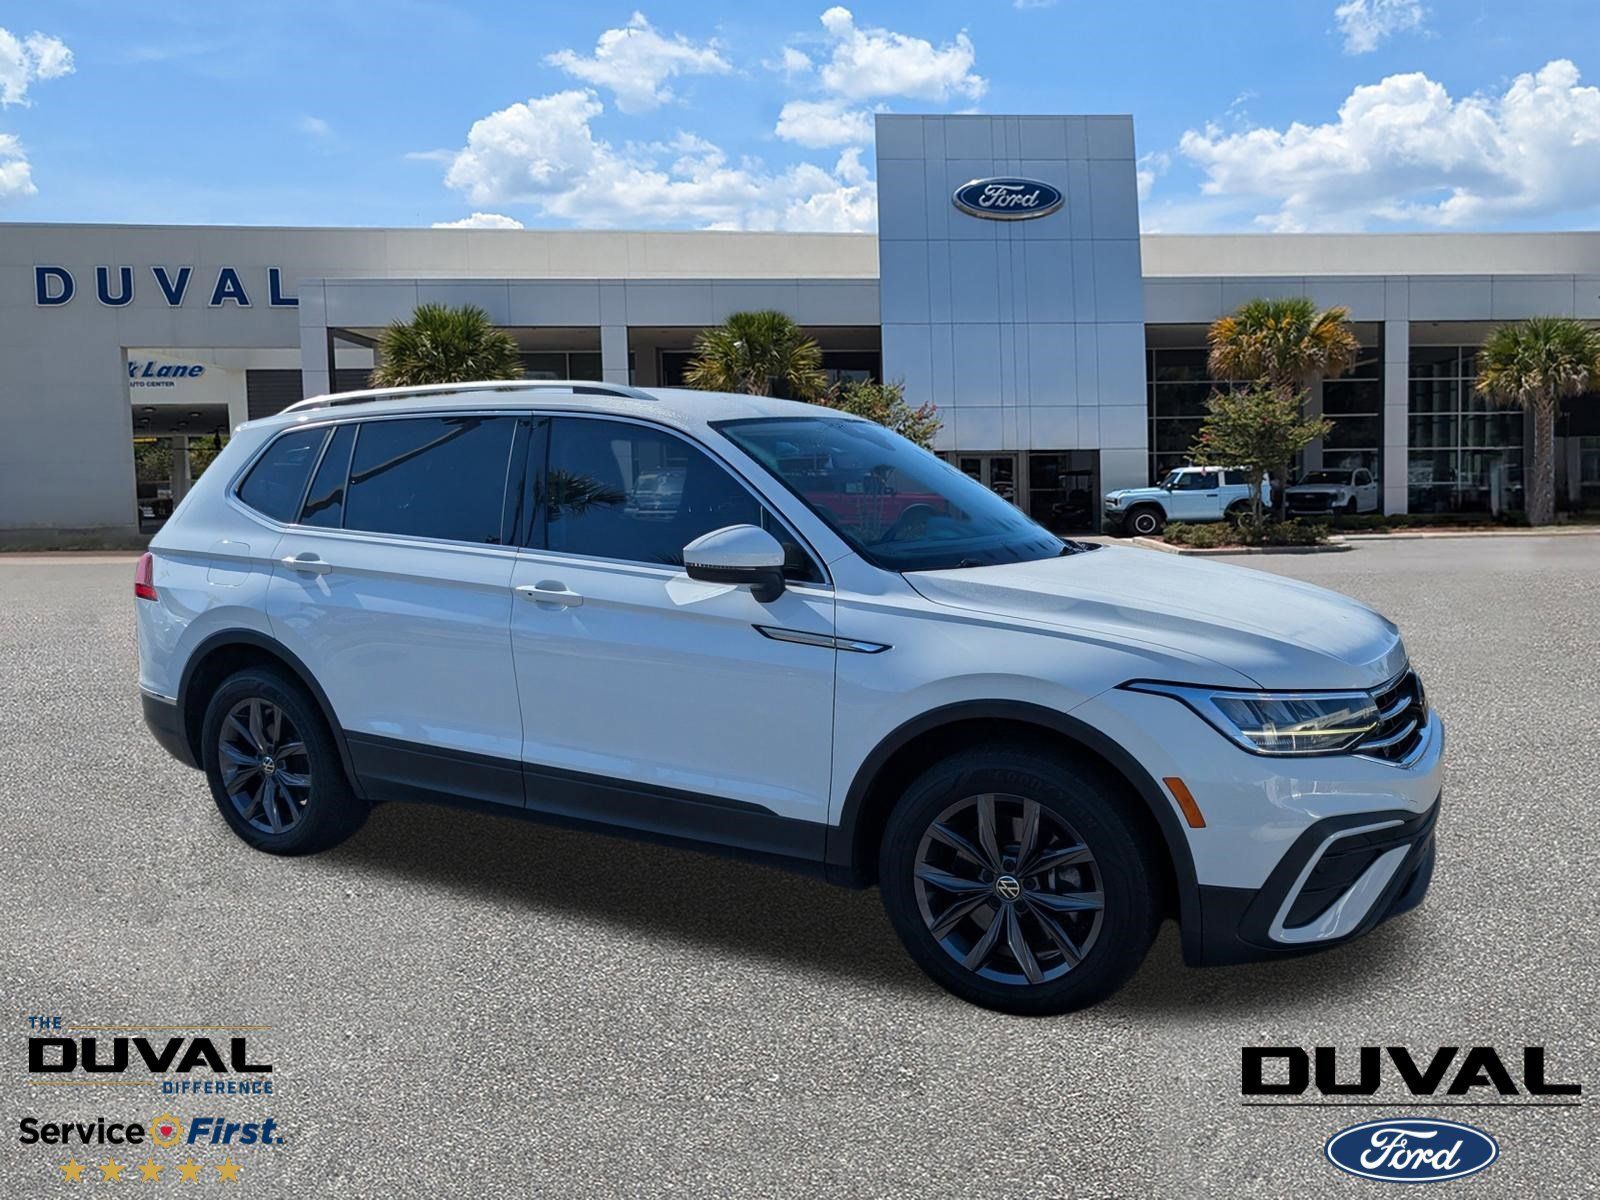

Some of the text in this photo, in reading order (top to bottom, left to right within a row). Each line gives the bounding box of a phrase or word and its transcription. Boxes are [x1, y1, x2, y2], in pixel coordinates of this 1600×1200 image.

[978, 184, 1040, 207] Ford
[34, 265, 299, 307] DUVAL
[141, 361, 205, 378] Lane
